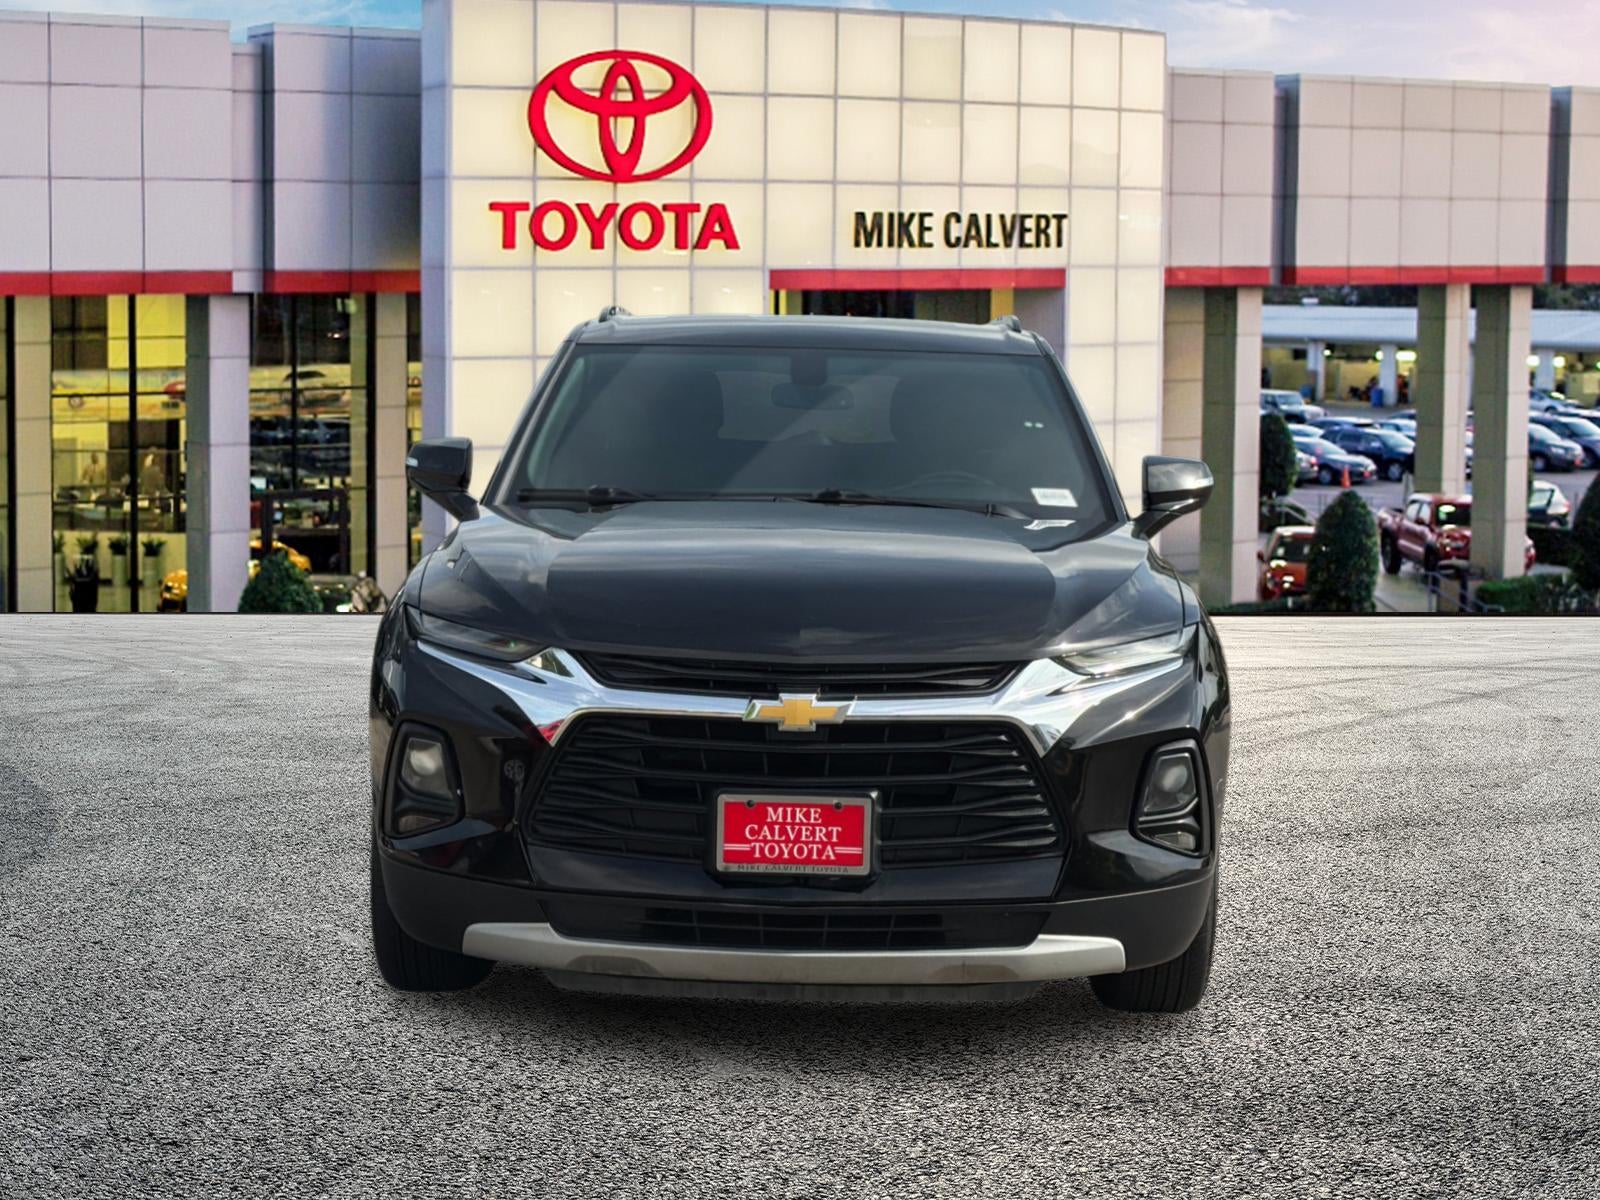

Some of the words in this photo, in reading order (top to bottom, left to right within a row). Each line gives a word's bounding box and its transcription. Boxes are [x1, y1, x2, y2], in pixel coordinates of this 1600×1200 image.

[489, 201, 740, 251] TOYOTA
[853, 211, 933, 248] MIKE
[943, 212, 1069, 248] CALVERT
[767, 807, 822, 823] MIKE
[745, 825, 842, 842] CALVERT
[751, 842, 836, 860] TOYOTA
